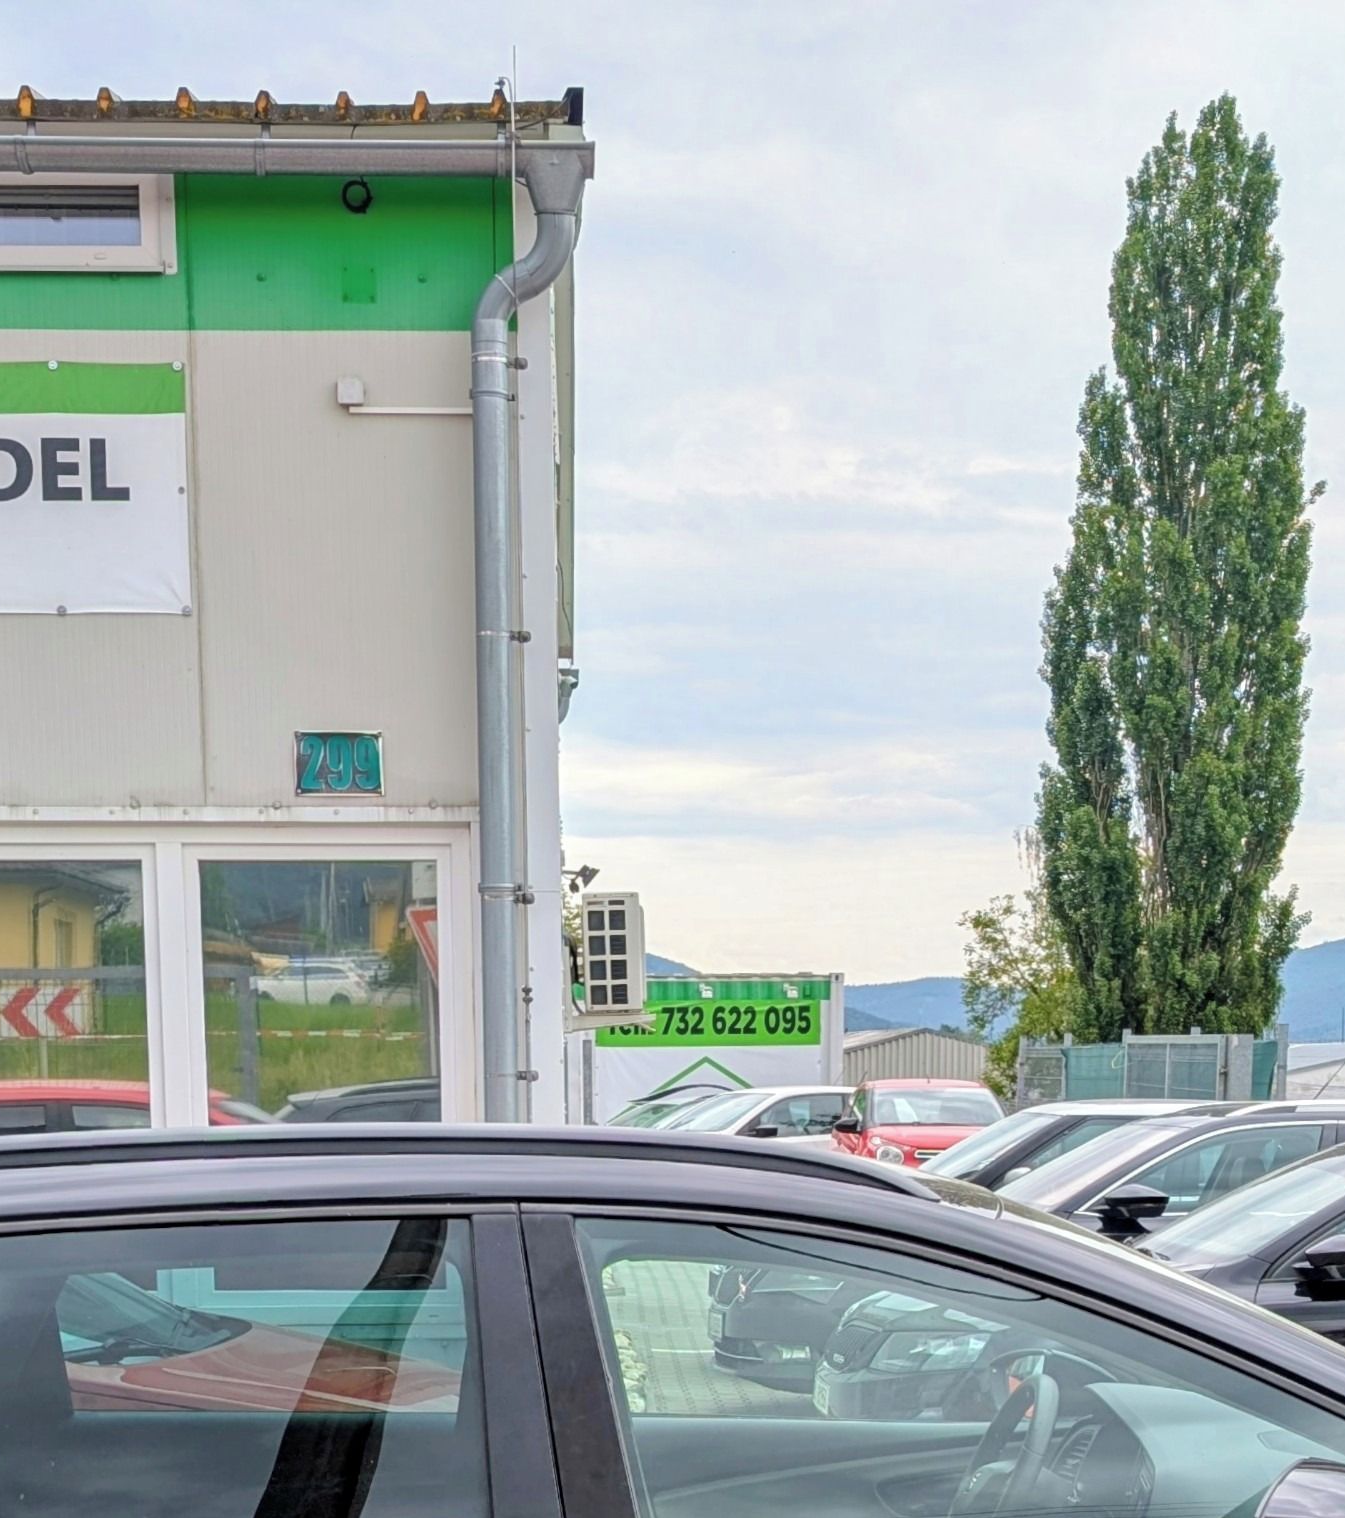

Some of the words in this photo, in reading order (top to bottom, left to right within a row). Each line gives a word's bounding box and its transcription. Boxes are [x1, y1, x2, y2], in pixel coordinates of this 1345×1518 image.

[299, 734, 380, 790] 299
[661, 1006, 705, 1035] 732
[712, 1005, 757, 1035] 622
[764, 1005, 811, 1035] 095
